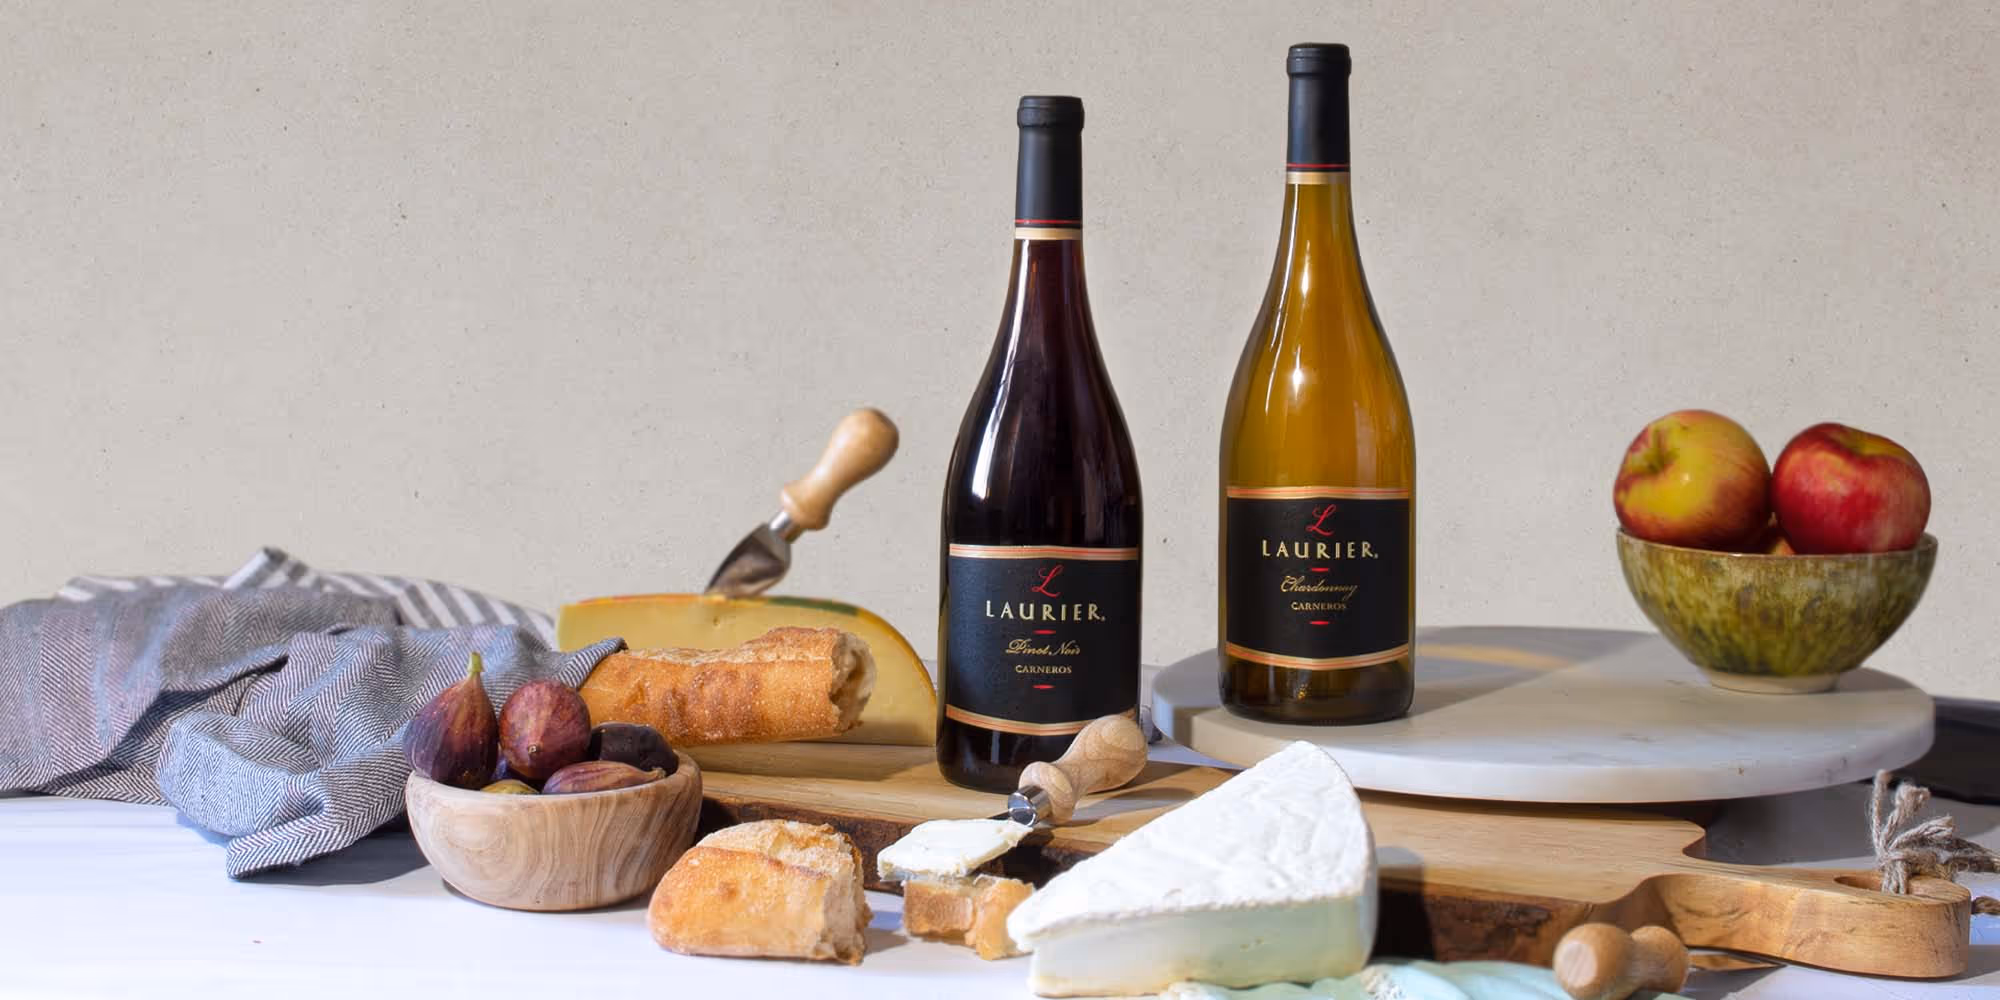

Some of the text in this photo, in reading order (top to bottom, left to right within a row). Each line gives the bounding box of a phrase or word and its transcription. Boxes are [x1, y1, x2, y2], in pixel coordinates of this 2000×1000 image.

[1280, 575, 1359, 600] Chardonnay
[1291, 601, 1347, 611] CARNEROS
[1005, 638, 1081, 656] Pinot Noir
[1015, 664, 1072, 674] CARNEROS
